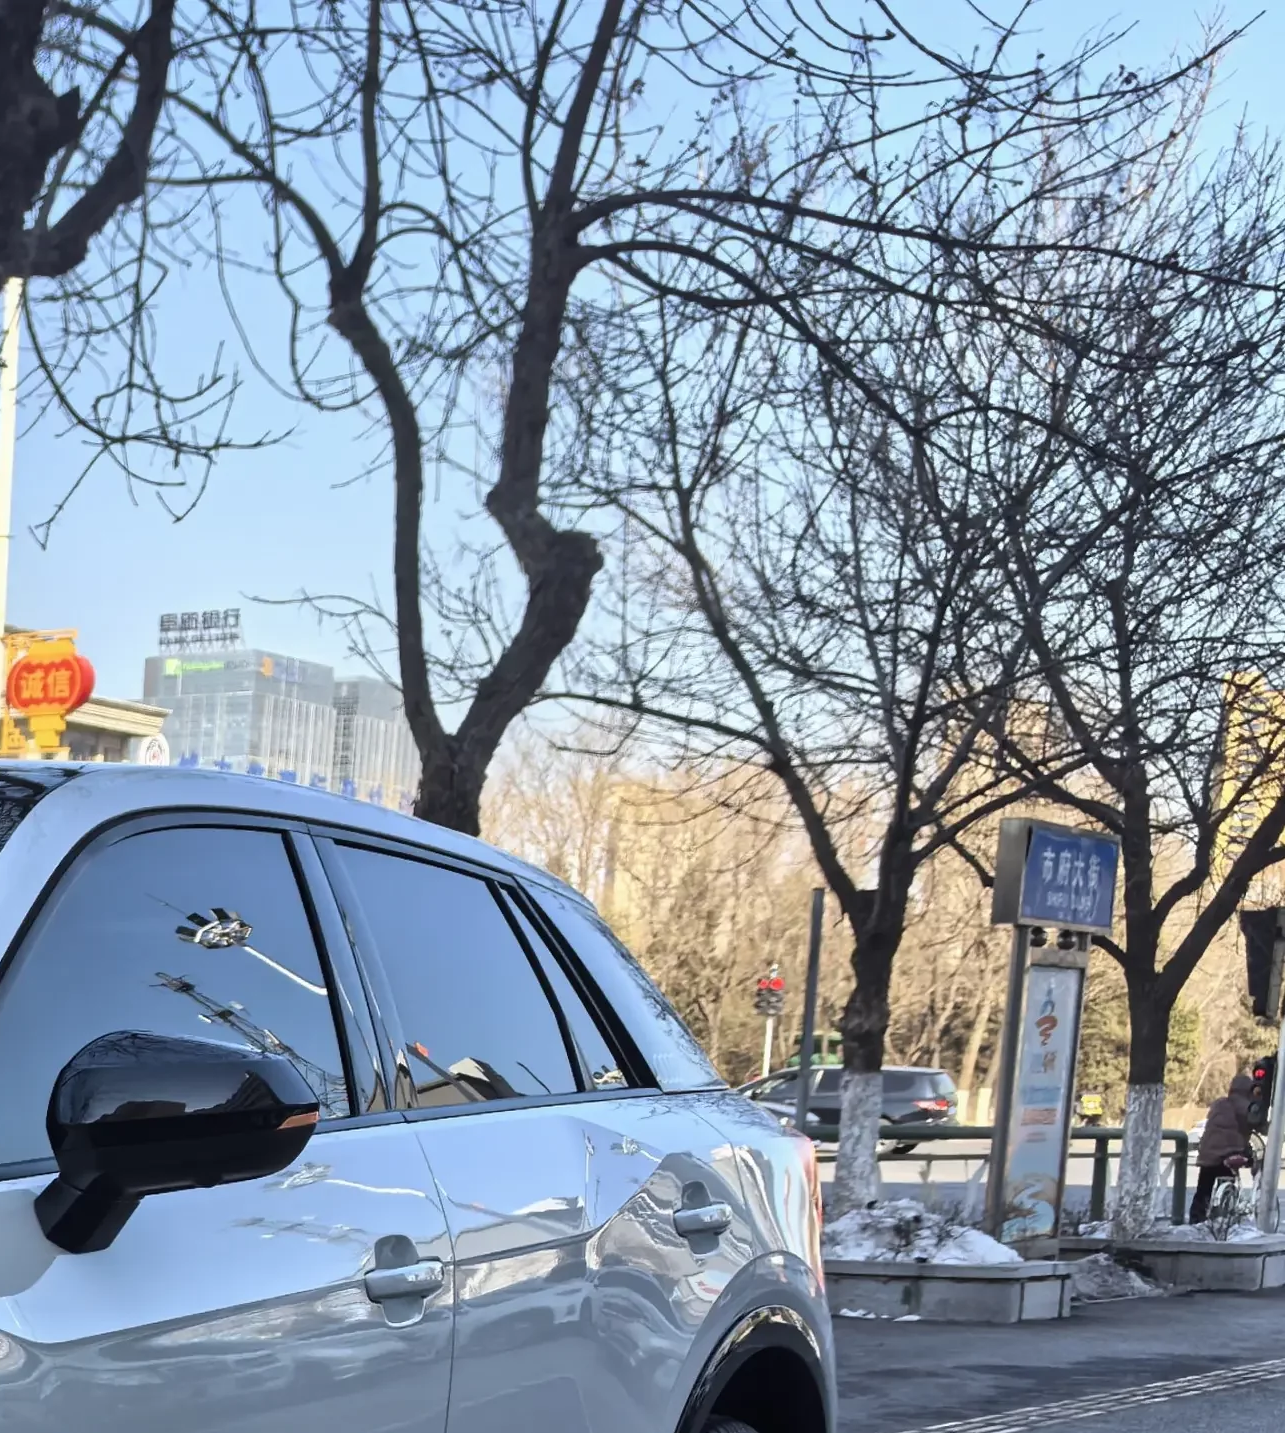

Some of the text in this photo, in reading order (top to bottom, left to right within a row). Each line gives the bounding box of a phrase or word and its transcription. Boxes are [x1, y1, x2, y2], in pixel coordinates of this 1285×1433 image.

[20, 668, 72, 699] 诚信
[1042, 846, 1101, 889] 市府大街
